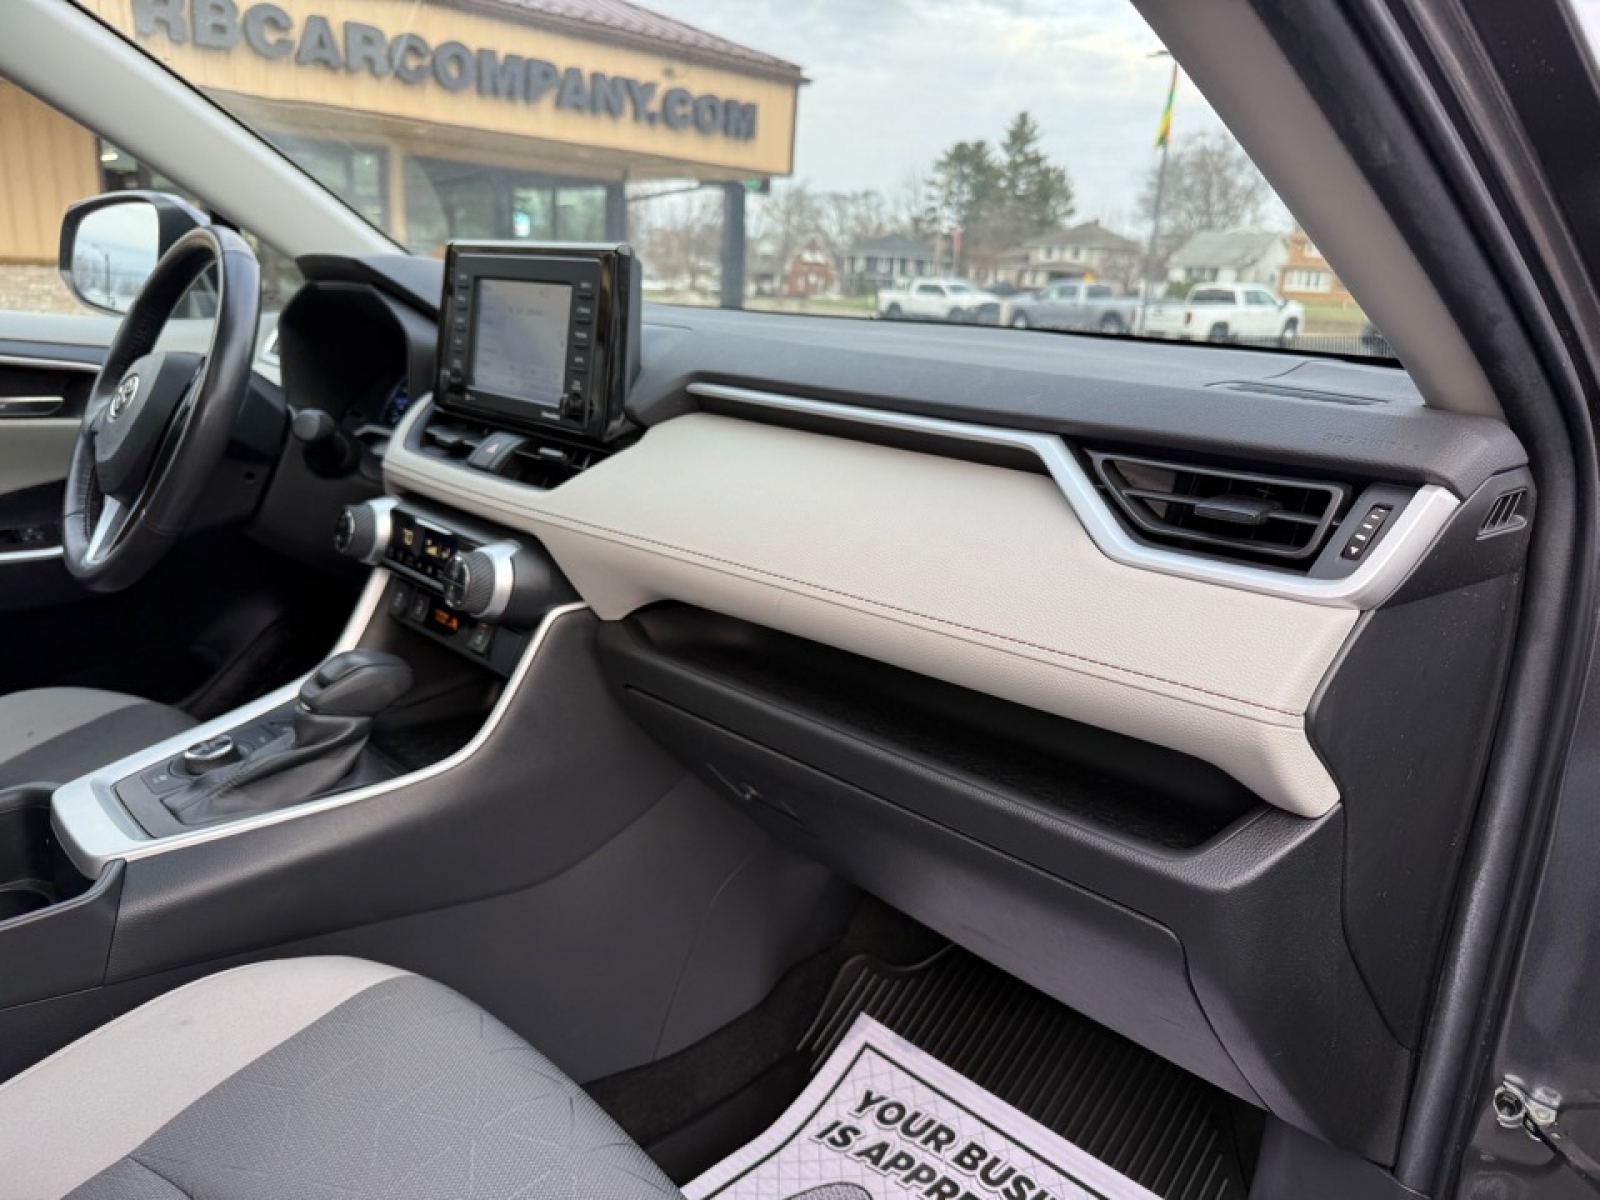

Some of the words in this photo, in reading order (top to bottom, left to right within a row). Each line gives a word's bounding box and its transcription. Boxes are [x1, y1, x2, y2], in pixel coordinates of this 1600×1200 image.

[815, 1119, 862, 1148] IS
[853, 1140, 981, 1200] APPR
[854, 1089, 956, 1153] YOUR
[953, 1141, 1056, 1200] BUS
